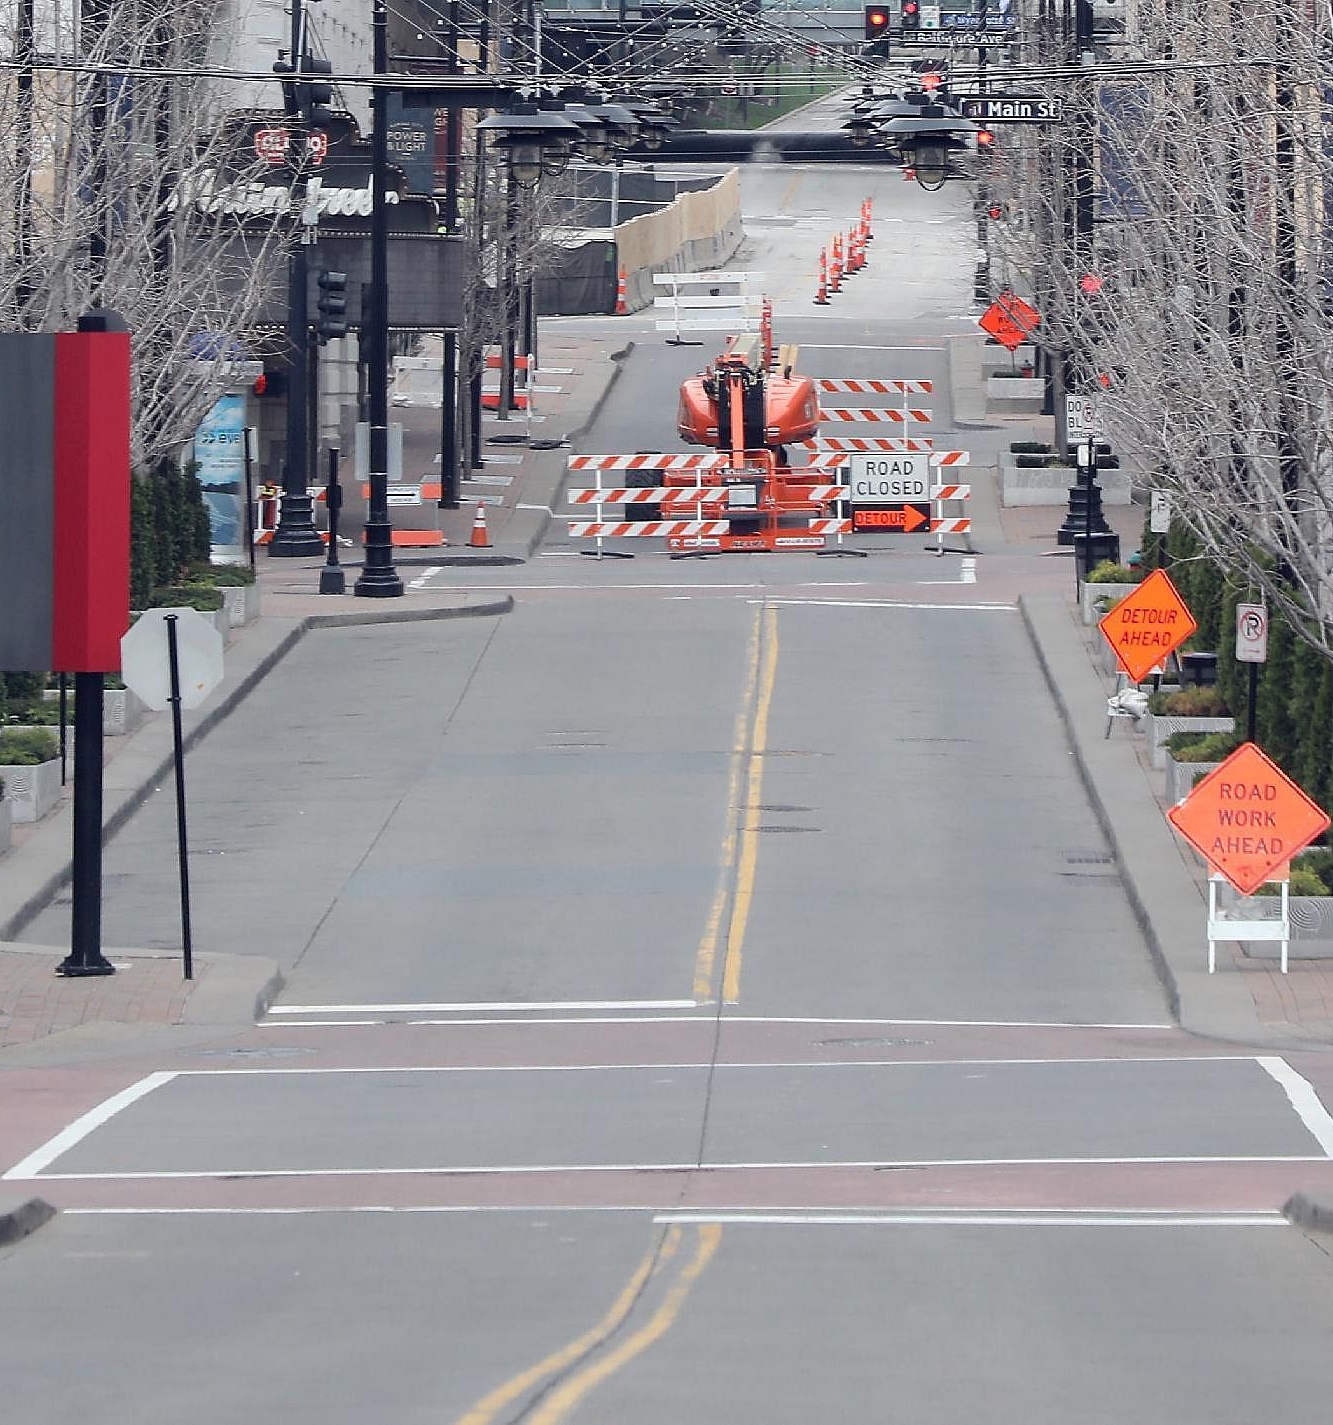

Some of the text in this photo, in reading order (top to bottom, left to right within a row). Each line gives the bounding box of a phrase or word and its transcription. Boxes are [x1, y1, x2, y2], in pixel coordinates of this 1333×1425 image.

[987, 101, 1056, 117] Main St
[386, 131, 427, 142] POWER
[395, 142, 427, 151] LIGHT
[866, 461, 914, 476] ROAD
[857, 481, 924, 496] CLOSED
[855, 513, 907, 524] DETOUR
[1122, 608, 1178, 624] DETOUR
[1120, 631, 1173, 647] AHEAD
[1220, 783, 1277, 801] ROAD
[1218, 809, 1277, 827] WORK
[1212, 837, 1284, 855] AHEAD
